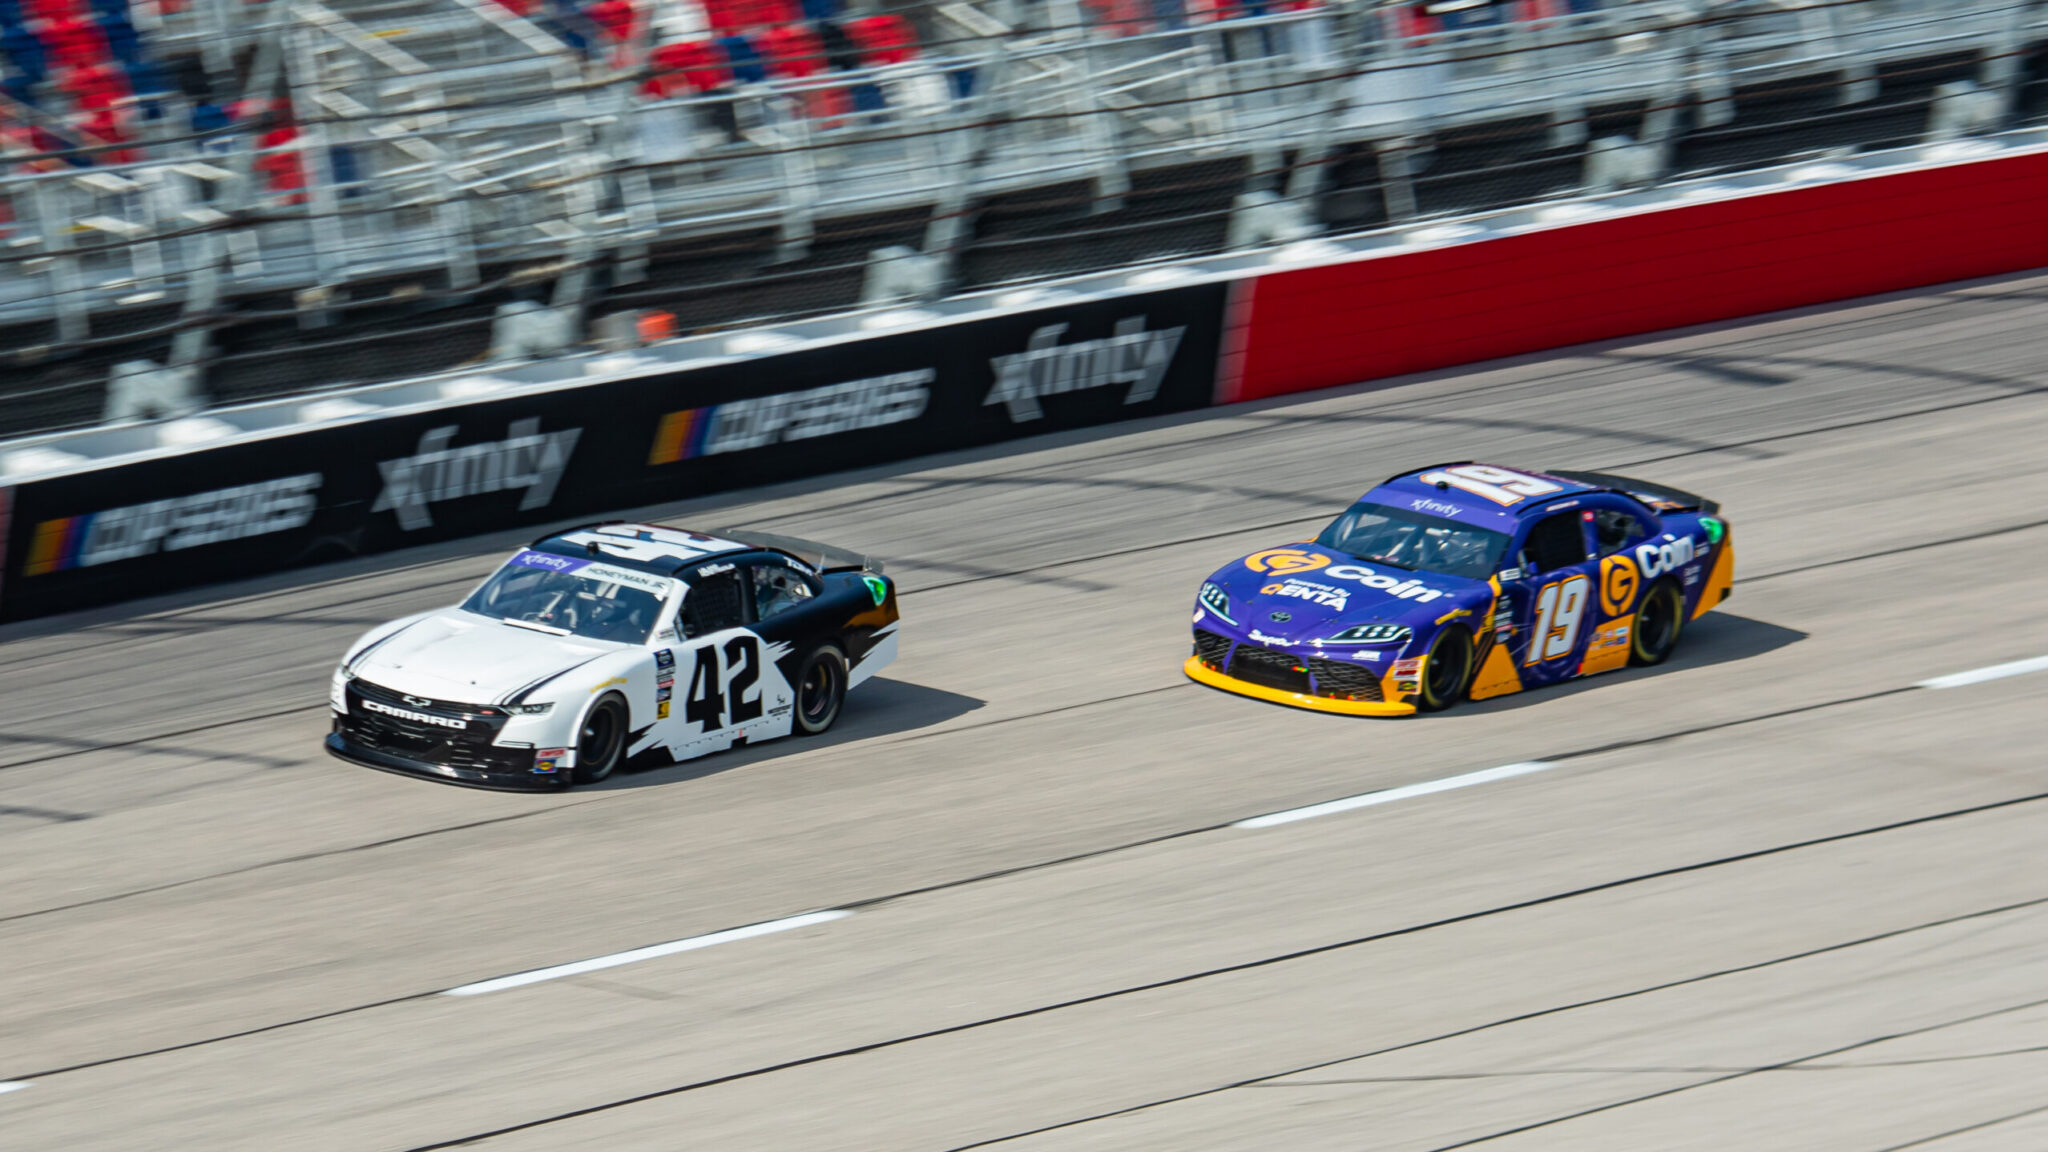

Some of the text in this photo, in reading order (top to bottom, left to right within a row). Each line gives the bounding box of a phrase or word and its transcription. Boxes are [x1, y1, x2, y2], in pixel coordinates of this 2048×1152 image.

[982, 315, 1188, 423] xfinity
[371, 416, 583, 531] xfinity
[1410, 499, 1463, 517] xfinity
[521, 553, 573, 570] xfinity
[1635, 534, 1695, 578] Coin
[1325, 565, 1443, 603] Coin
[1524, 574, 1591, 667] 19
[686, 635, 763, 733] 42
[362, 699, 467, 730] CAMARO
